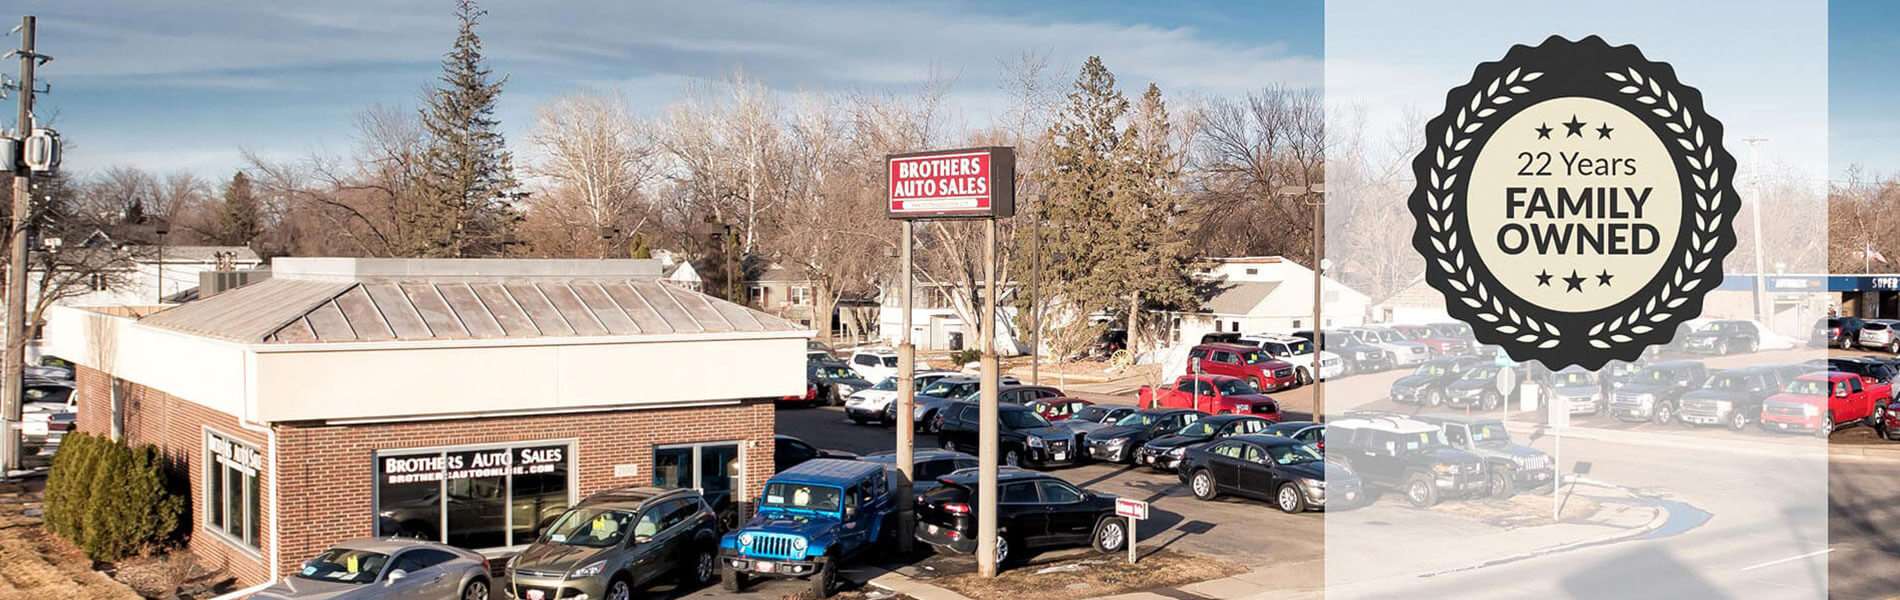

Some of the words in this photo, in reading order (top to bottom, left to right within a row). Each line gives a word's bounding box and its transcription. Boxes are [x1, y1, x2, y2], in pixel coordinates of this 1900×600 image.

[900, 158, 980, 178] BROTHERS
[894, 179, 936, 197] AUTO
[939, 176, 986, 195] SALES
[471, 452, 513, 469] AUTO
[521, 448, 562, 465] SALES
